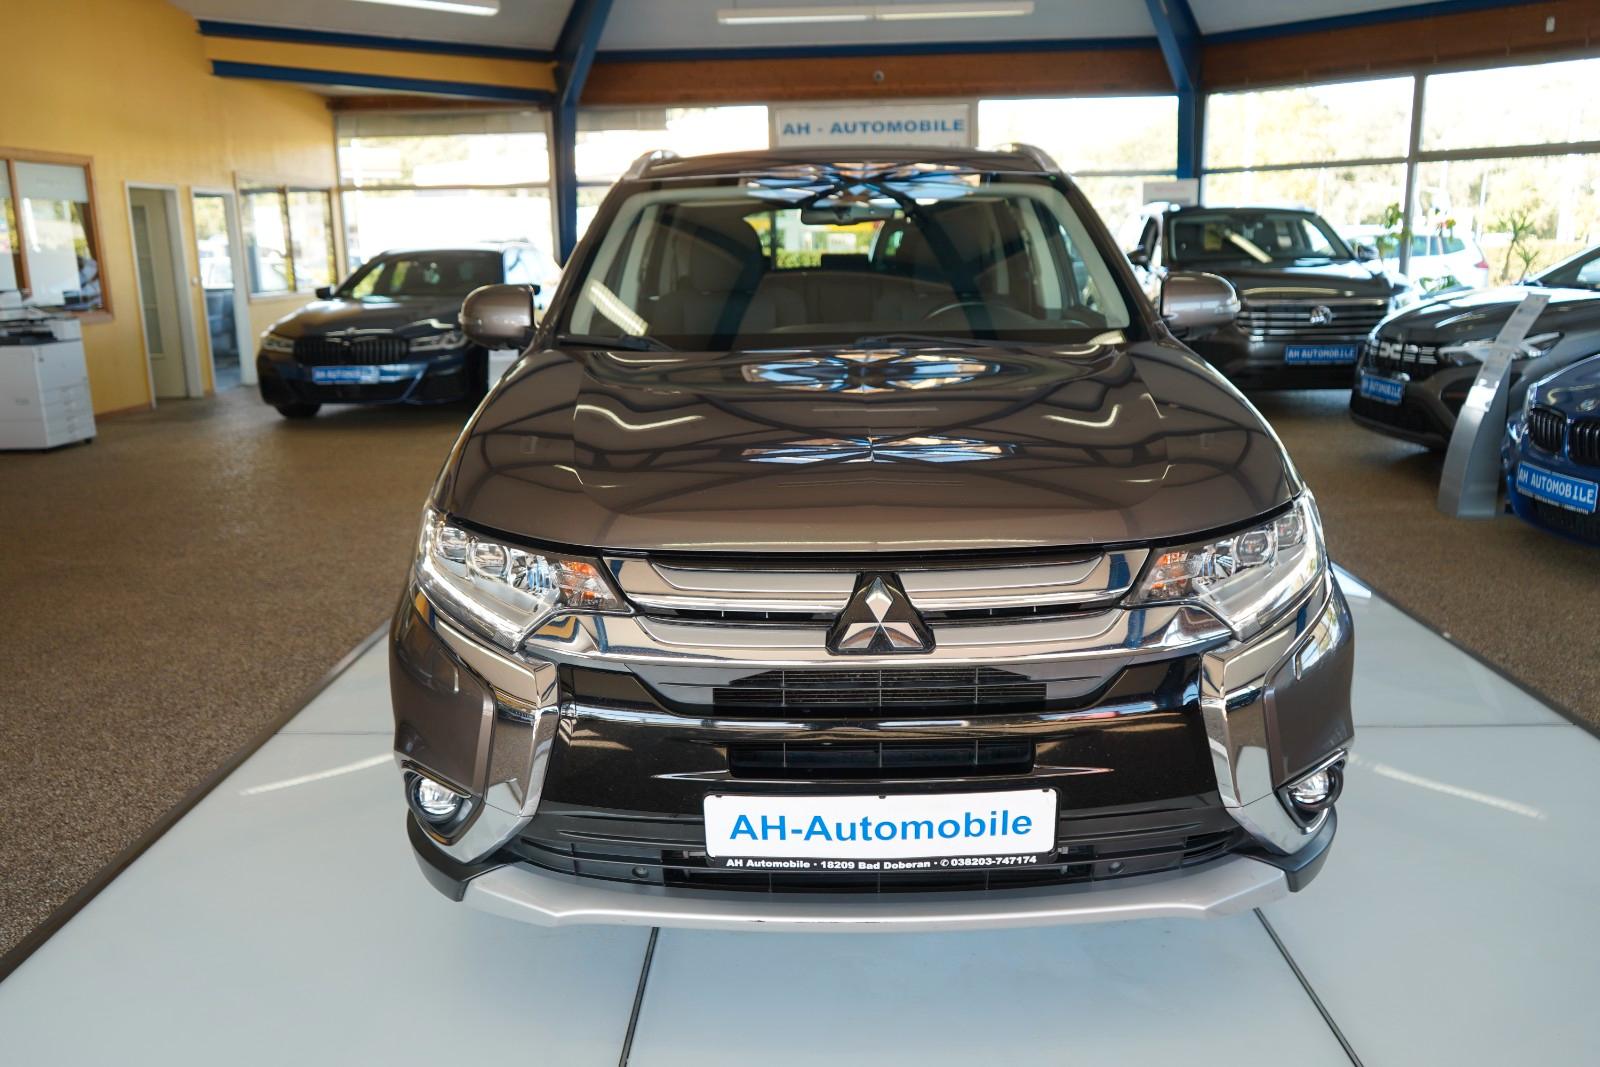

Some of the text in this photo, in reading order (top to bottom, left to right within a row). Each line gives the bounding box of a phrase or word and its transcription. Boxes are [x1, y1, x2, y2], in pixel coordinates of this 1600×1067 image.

[782, 122, 811, 136] AH
[829, 118, 965, 135] AUTOMOBILE
[1530, 472, 1595, 504] AUTOMOBILE
[729, 809, 1033, 841] AH-Automobile
[726, 855, 1037, 869] AH Automobile 18209 Bad Doberan 038203-747174
